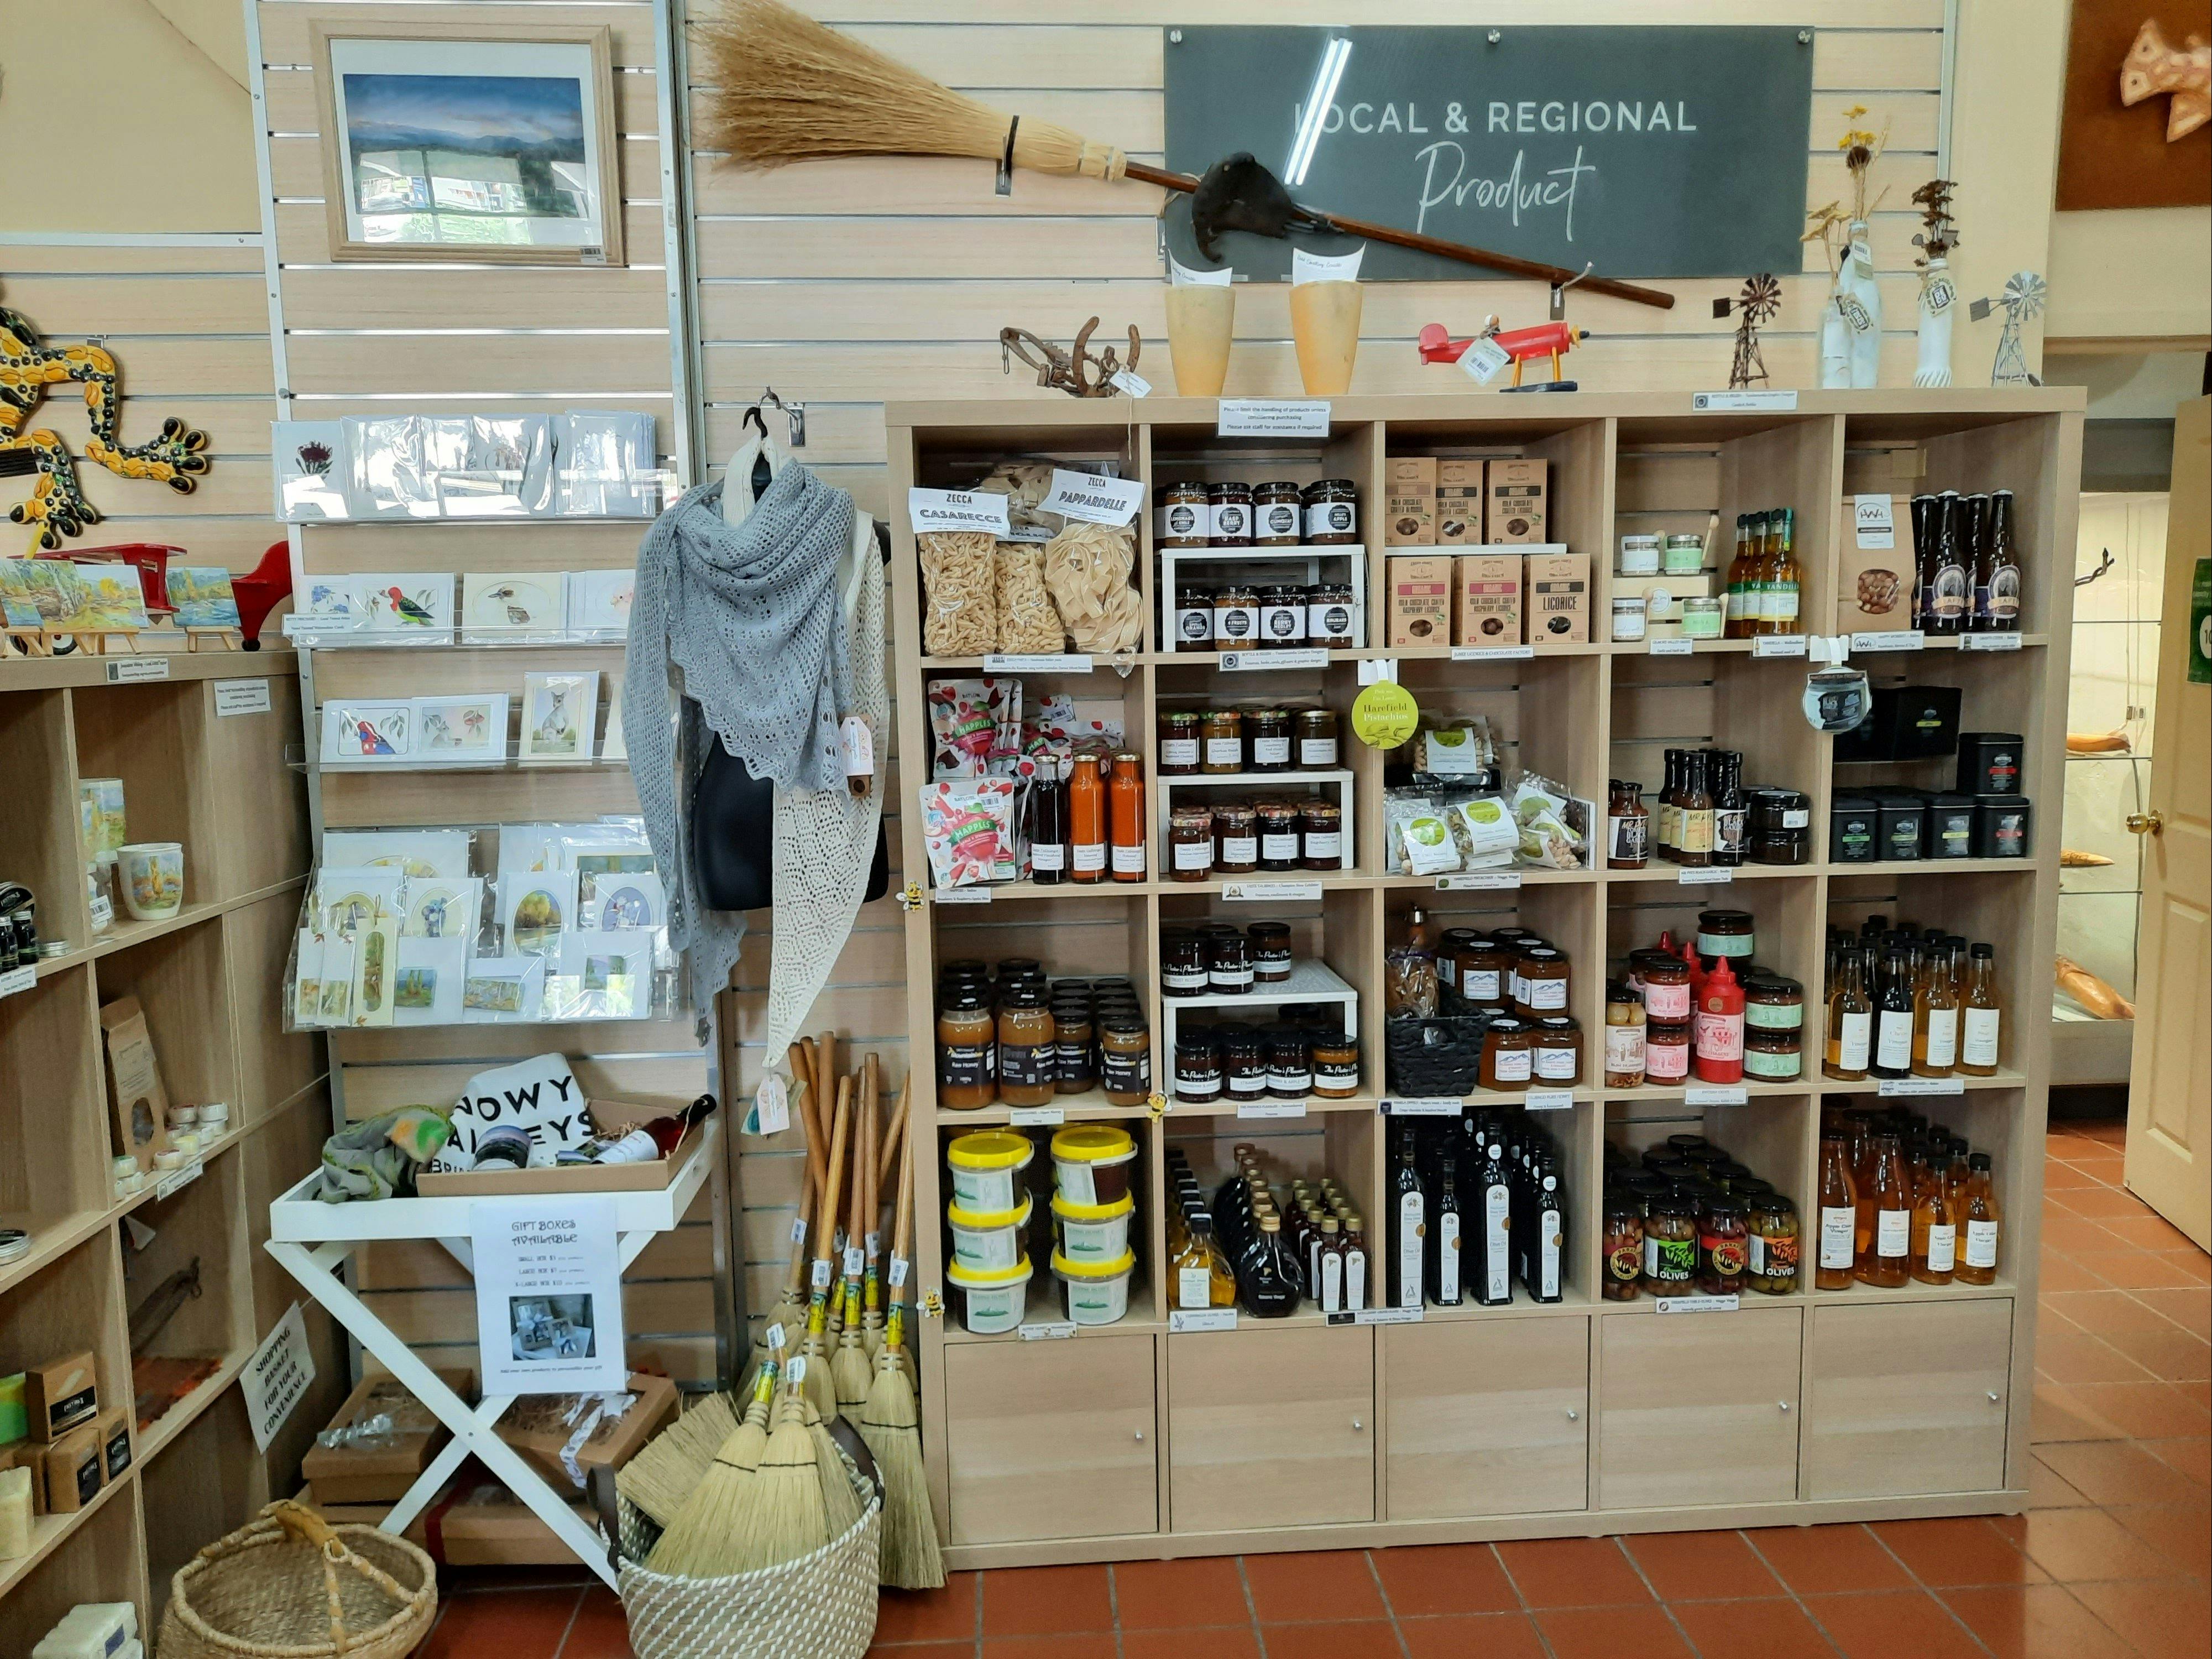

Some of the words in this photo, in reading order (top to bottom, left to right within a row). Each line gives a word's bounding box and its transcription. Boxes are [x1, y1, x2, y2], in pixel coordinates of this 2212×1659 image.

[1295, 102, 1428, 134] LOCAL
[1445, 102, 1469, 133] &
[1488, 101, 1697, 133] REGIONAL
[1415, 140, 1596, 242] Product
[1087, 476, 1106, 488] ZECCA
[946, 493, 972, 504] ZECCA
[1059, 490, 1128, 512] PAPPARDELLE
[919, 509, 1003, 524] CASARECCE
[1543, 596, 1577, 612] LICORICE
[1363, 703, 1408, 712] Harefield
[1363, 712, 1409, 722] Pistachios
[958, 719, 991, 734] HAPPLES
[954, 820, 990, 839] HAPPLES
[511, 1220, 537, 1232] GIFT
[538, 1219, 577, 1232] BOXES
[511, 1233, 578, 1246] AVAILABLE
[1659, 1270, 1689, 1281] OLIVES
[1766, 1266, 1795, 1277] OLIVES
[255, 1326, 291, 1376] SHOPPING
[264, 1385, 279, 1411] FOR
[278, 1360, 297, 1389] YOUR
[264, 1371, 307, 1435] CONVENIENCE
